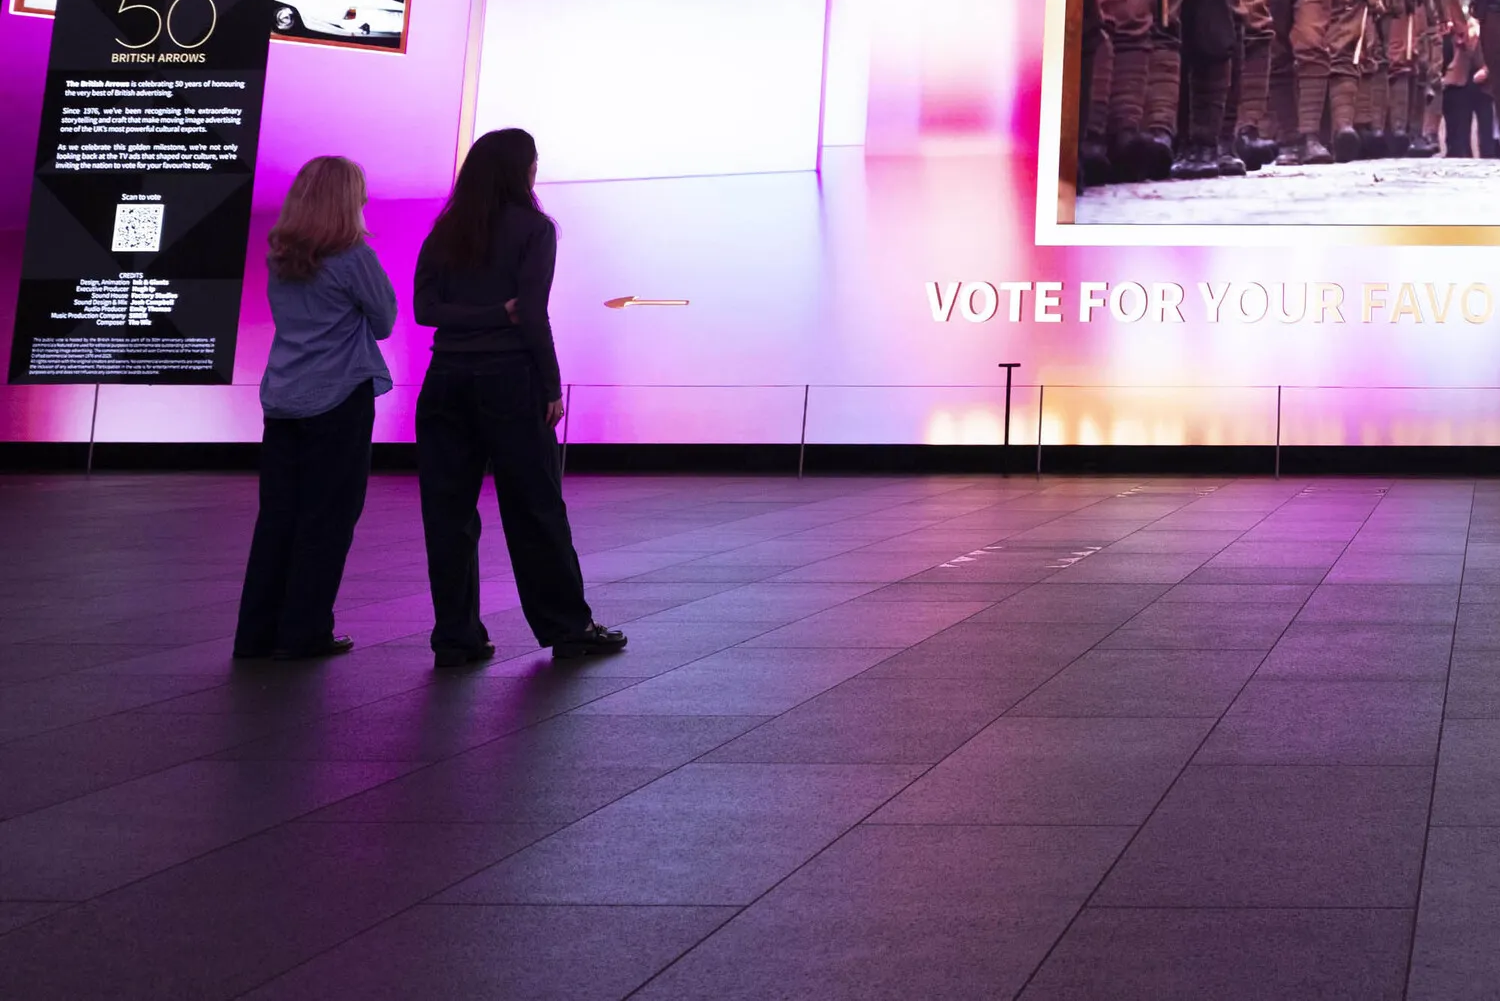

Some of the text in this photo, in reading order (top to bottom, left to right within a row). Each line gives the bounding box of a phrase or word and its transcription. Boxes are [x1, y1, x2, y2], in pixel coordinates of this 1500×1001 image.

[111, 53, 206, 63] BRITISH ARROWS
[138, 81, 174, 89] celebrating
[211, 81, 245, 89] honouring
[144, 108, 182, 116] recognising
[198, 108, 242, 116] extraordinary
[160, 117, 185, 125] moving
[205, 117, 241, 125] advertising
[125, 126, 155, 134] powerful
[128, 144, 151, 153] golden
[223, 144, 238, 153] only
[56, 153, 81, 162] looking
[156, 153, 180, 162] shaped
[55, 162, 80, 171] inviting
[925, 281, 1063, 323] VOTE
[1079, 281, 1185, 323] FOR
[1198, 281, 1346, 324] YOUR
